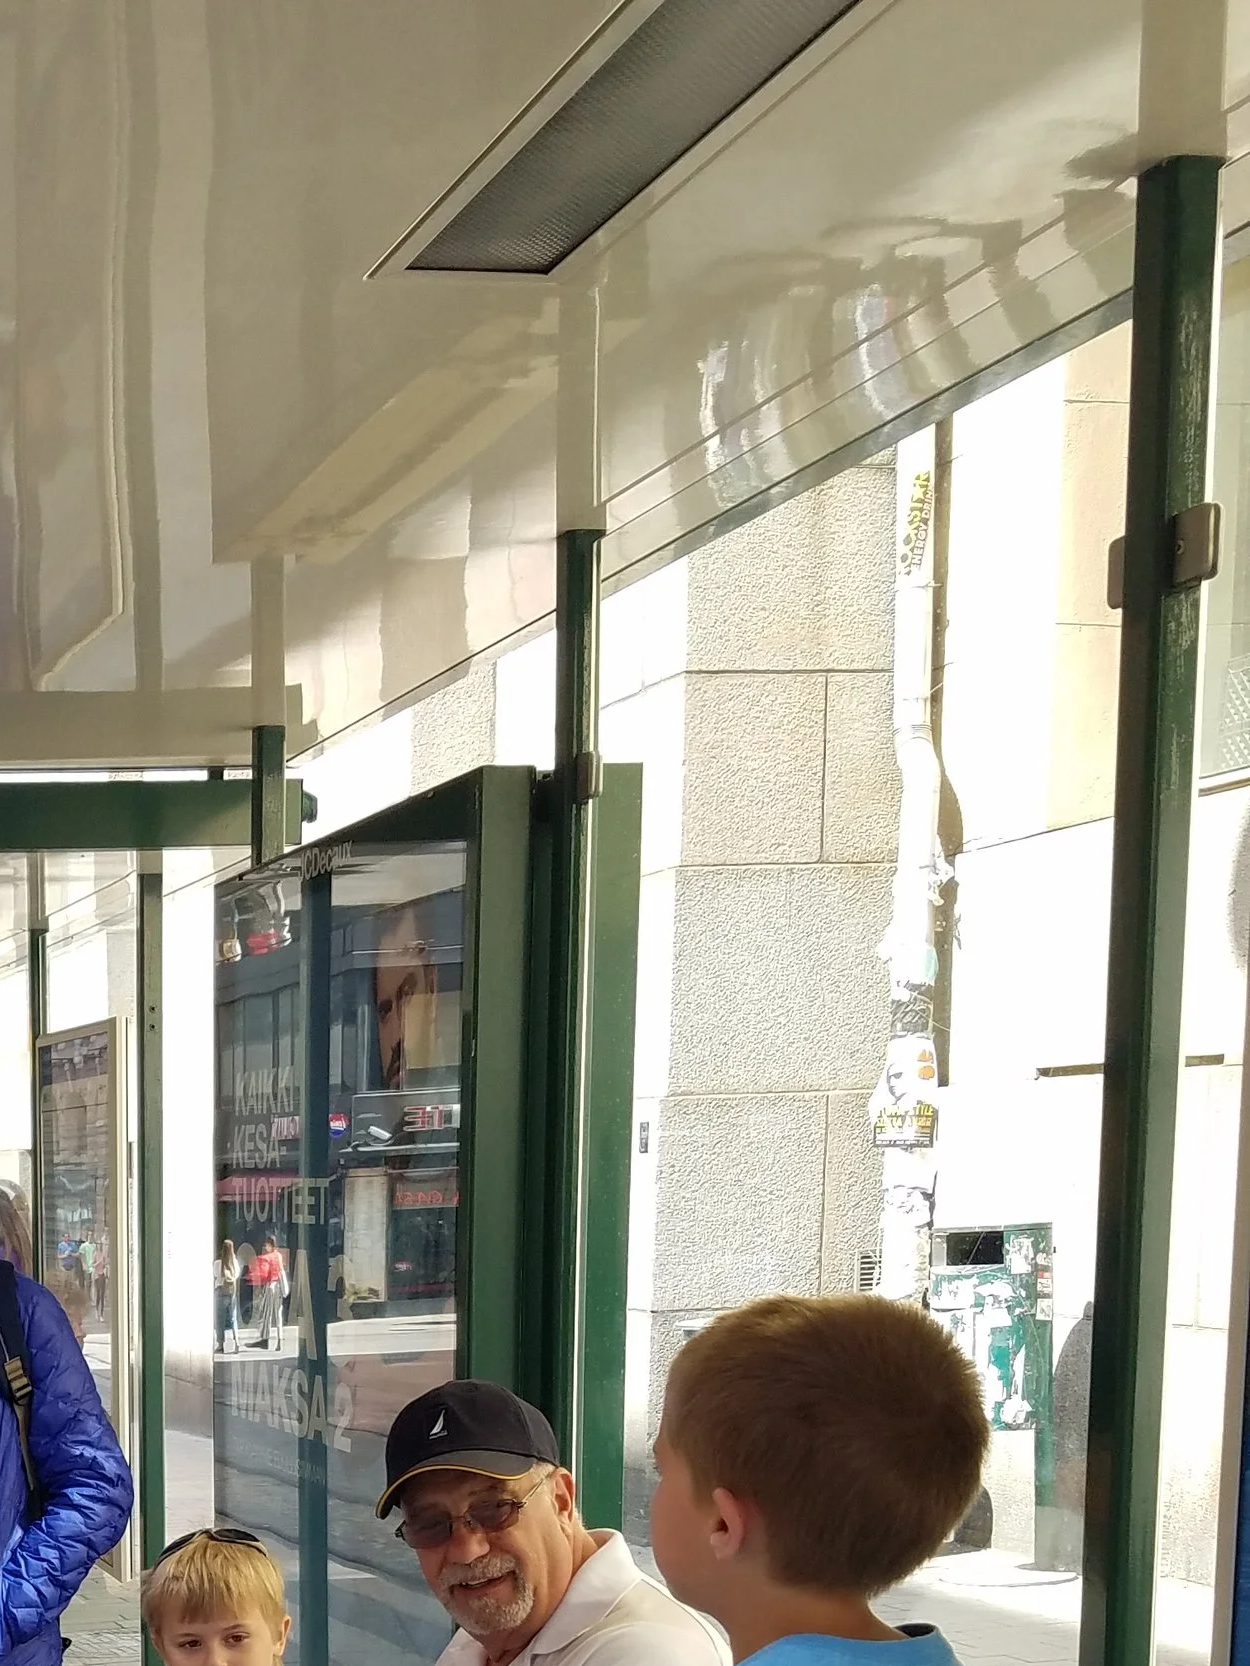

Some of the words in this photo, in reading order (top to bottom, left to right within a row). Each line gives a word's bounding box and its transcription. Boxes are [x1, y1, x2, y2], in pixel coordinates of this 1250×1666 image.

[300, 840, 352, 882] JCDecaux
[235, 1065, 295, 1116] KAIKKI
[231, 1177, 329, 1225] TUOTTEET
[231, 1361, 328, 1446] MAKSA
[334, 1382, 354, 1453] 2
